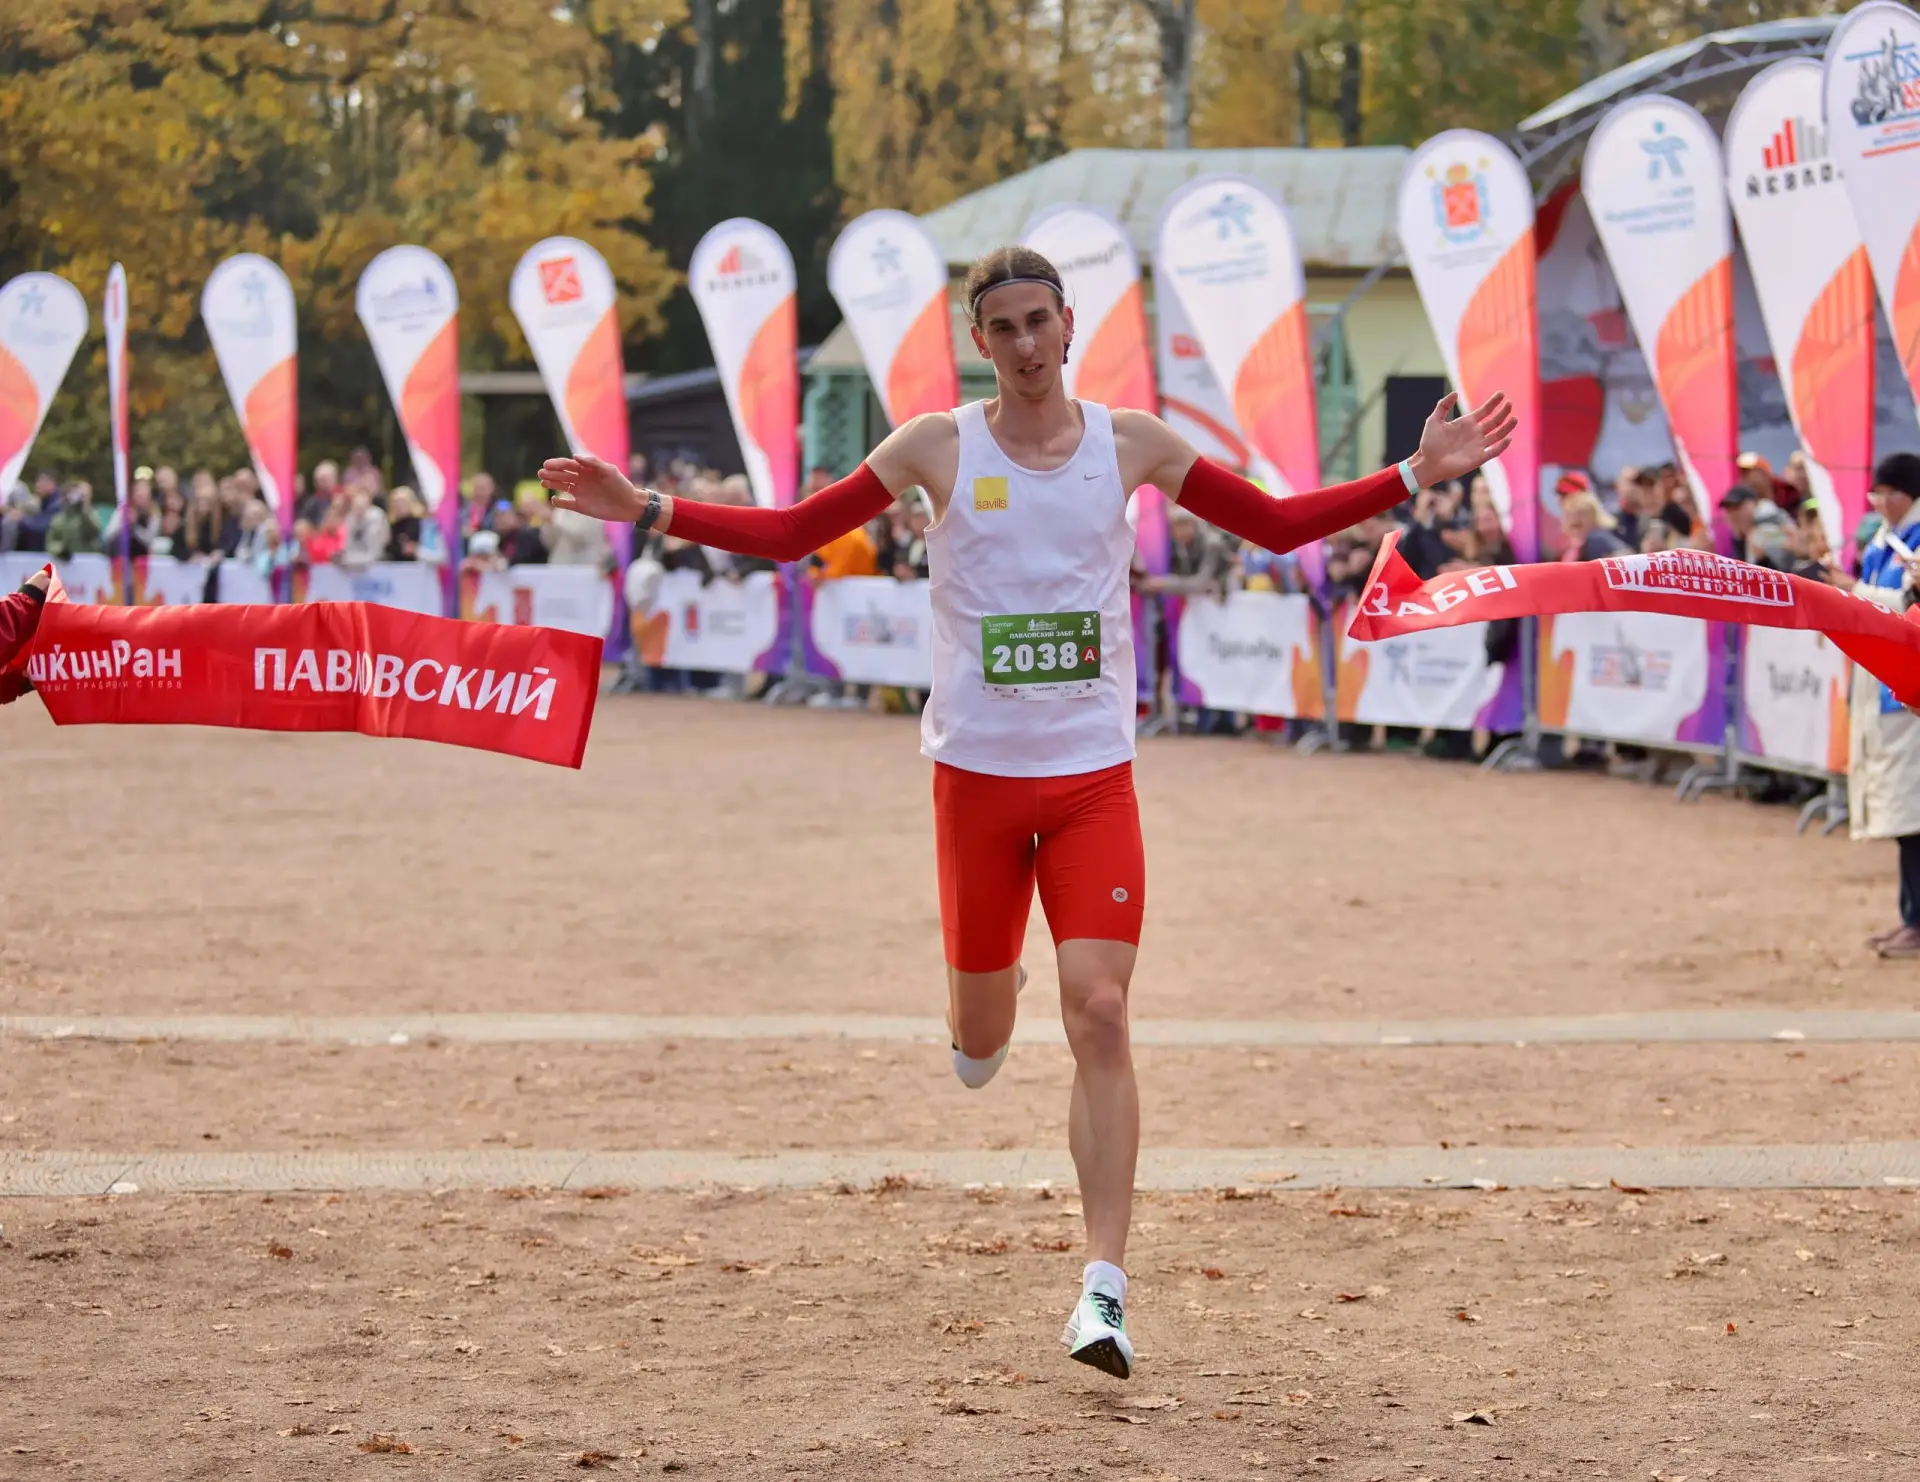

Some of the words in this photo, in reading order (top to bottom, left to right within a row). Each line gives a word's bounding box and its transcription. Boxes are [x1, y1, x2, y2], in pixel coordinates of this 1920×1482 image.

[976, 498, 1008, 509] savills
[1362, 564, 1520, 617] ЗАБЕГ
[1083, 617, 1092, 629] 3
[992, 642, 1078, 673] 2038
[254, 647, 557, 721] ПАВЛОВСКИЙ
